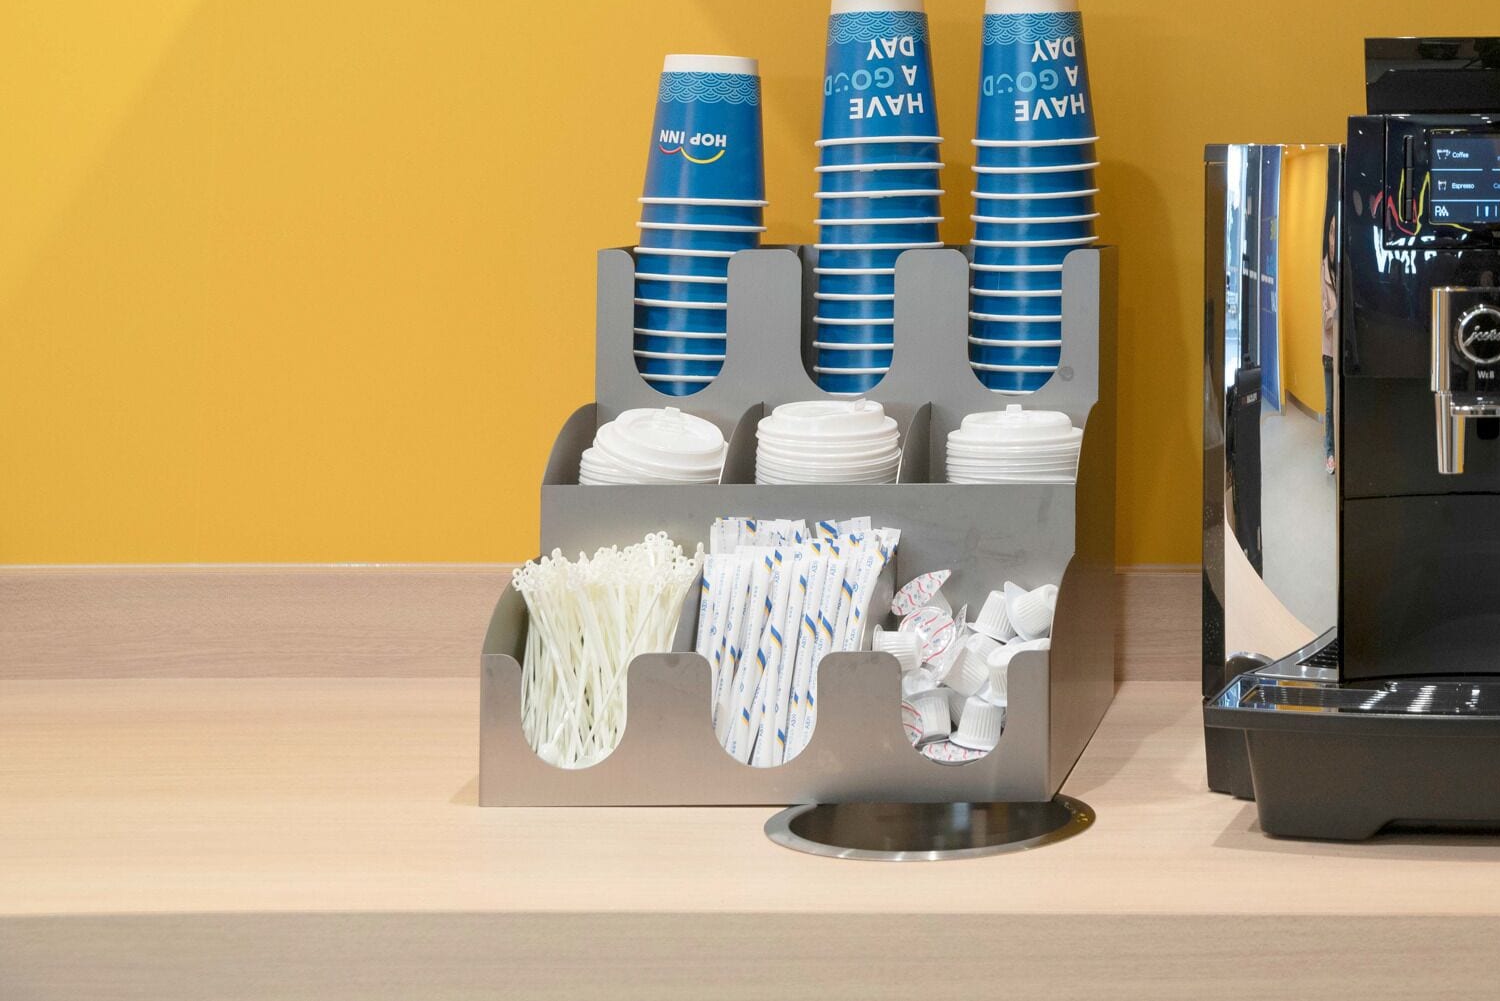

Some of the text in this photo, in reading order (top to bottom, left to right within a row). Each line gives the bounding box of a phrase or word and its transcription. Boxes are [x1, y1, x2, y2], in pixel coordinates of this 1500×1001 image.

[866, 36, 915, 60] DAY
[1031, 36, 1076, 63] DAY
[901, 65, 917, 86] A
[1064, 65, 1078, 87] A
[849, 92, 924, 120] HAVE
[1014, 93, 1086, 122] HAVE
[659, 129, 727, 148] HOP INN
[1452, 182, 1475, 190] Espresso
